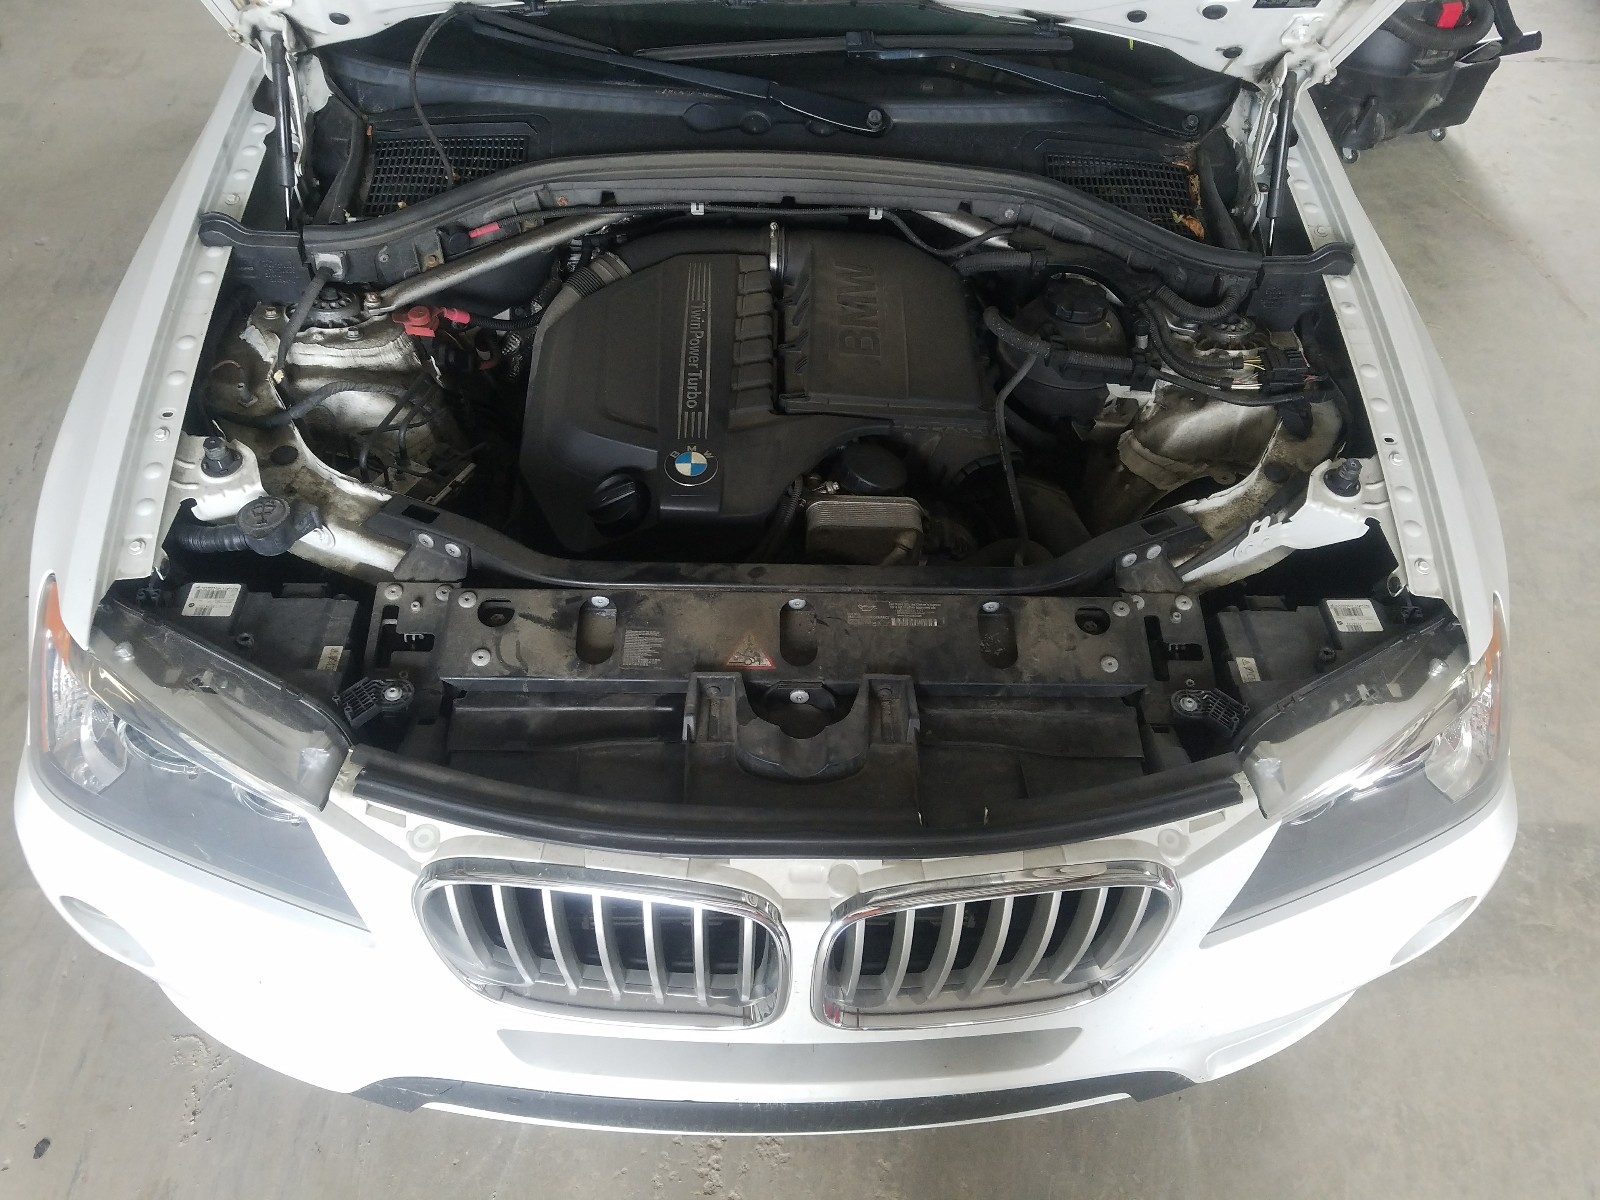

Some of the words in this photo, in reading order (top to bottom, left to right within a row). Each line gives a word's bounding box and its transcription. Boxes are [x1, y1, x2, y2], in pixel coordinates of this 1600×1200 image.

[688, 299, 706, 369] TwinPower
[833, 260, 881, 358] BMW
[686, 369, 703, 409] Turbo
[670, 445, 714, 459] BMW
